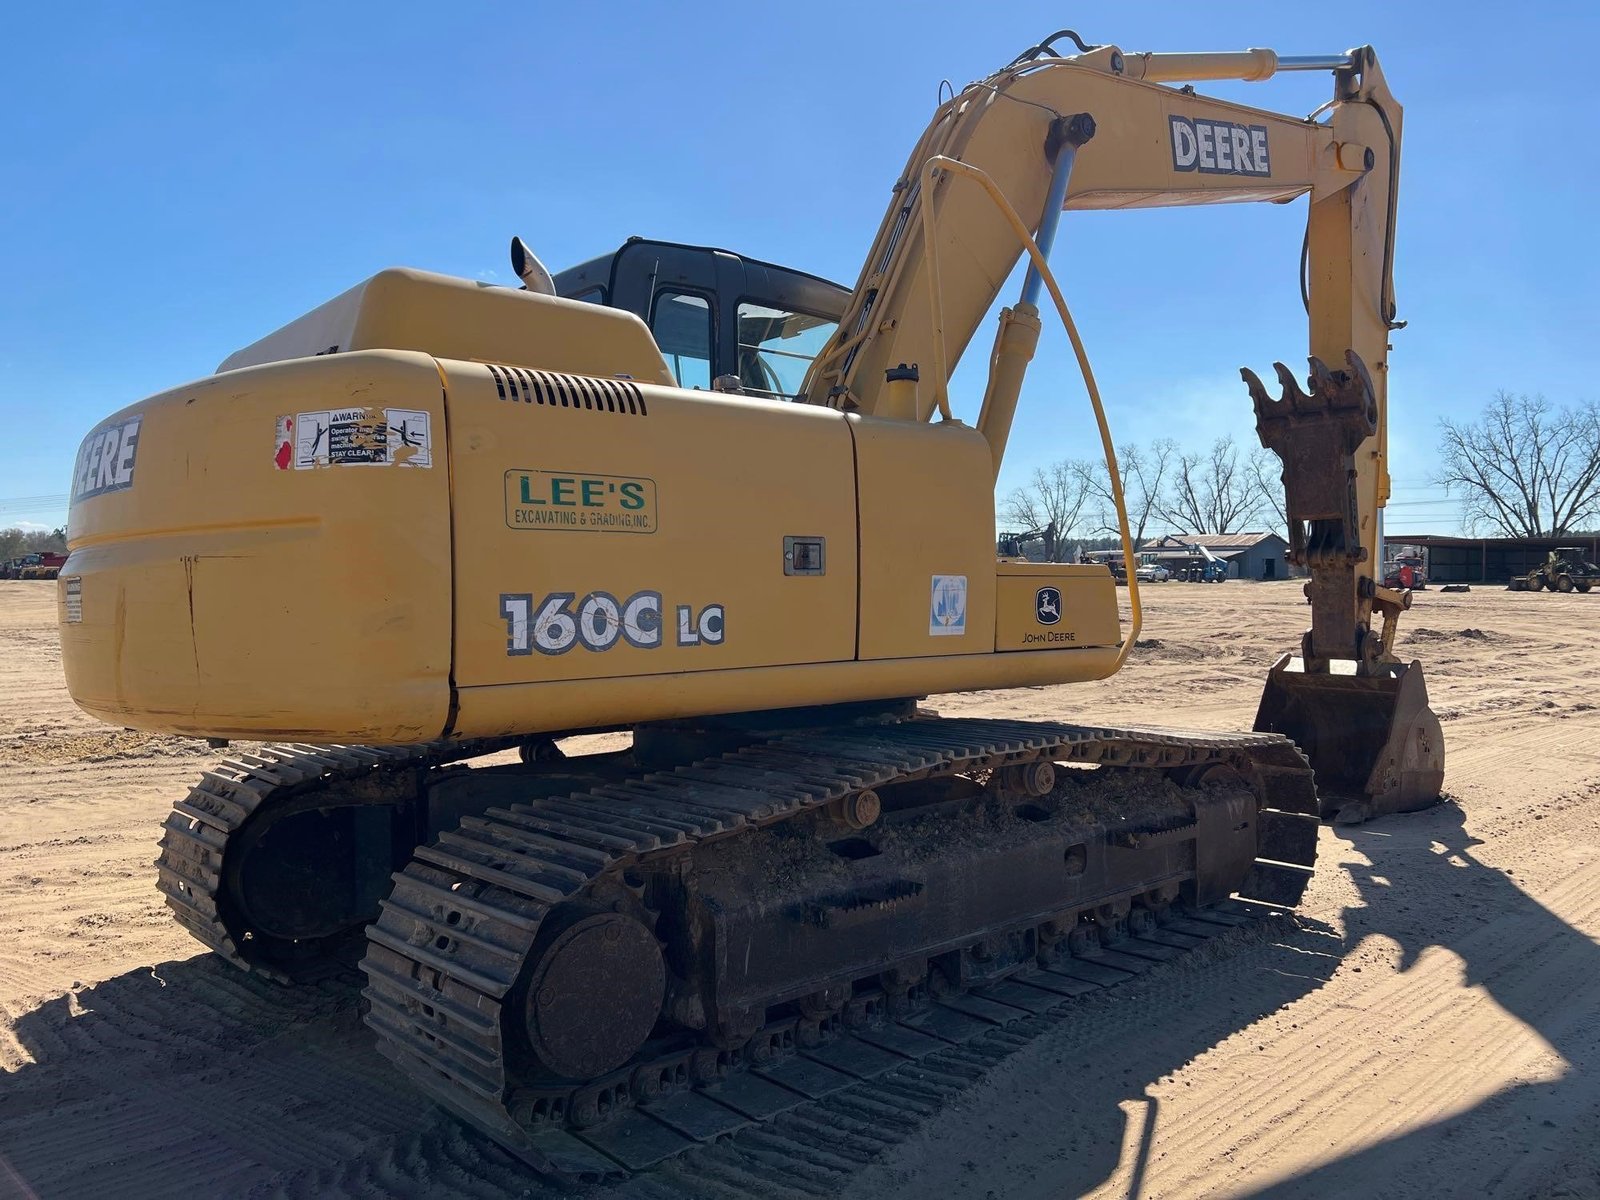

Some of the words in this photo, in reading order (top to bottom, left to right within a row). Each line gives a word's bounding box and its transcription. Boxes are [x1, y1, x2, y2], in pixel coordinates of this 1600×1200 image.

[1171, 119, 1270, 174] DEERE
[331, 427, 358, 436] Operator
[519, 476, 645, 510] LEE'S
[515, 509, 576, 525] EXCAVATING
[580, 512, 586, 525] &
[503, 594, 660, 653] 160C
[678, 605, 723, 643] LC
[1022, 632, 1046, 643] JOHN
[1047, 631, 1076, 642] DEERE
